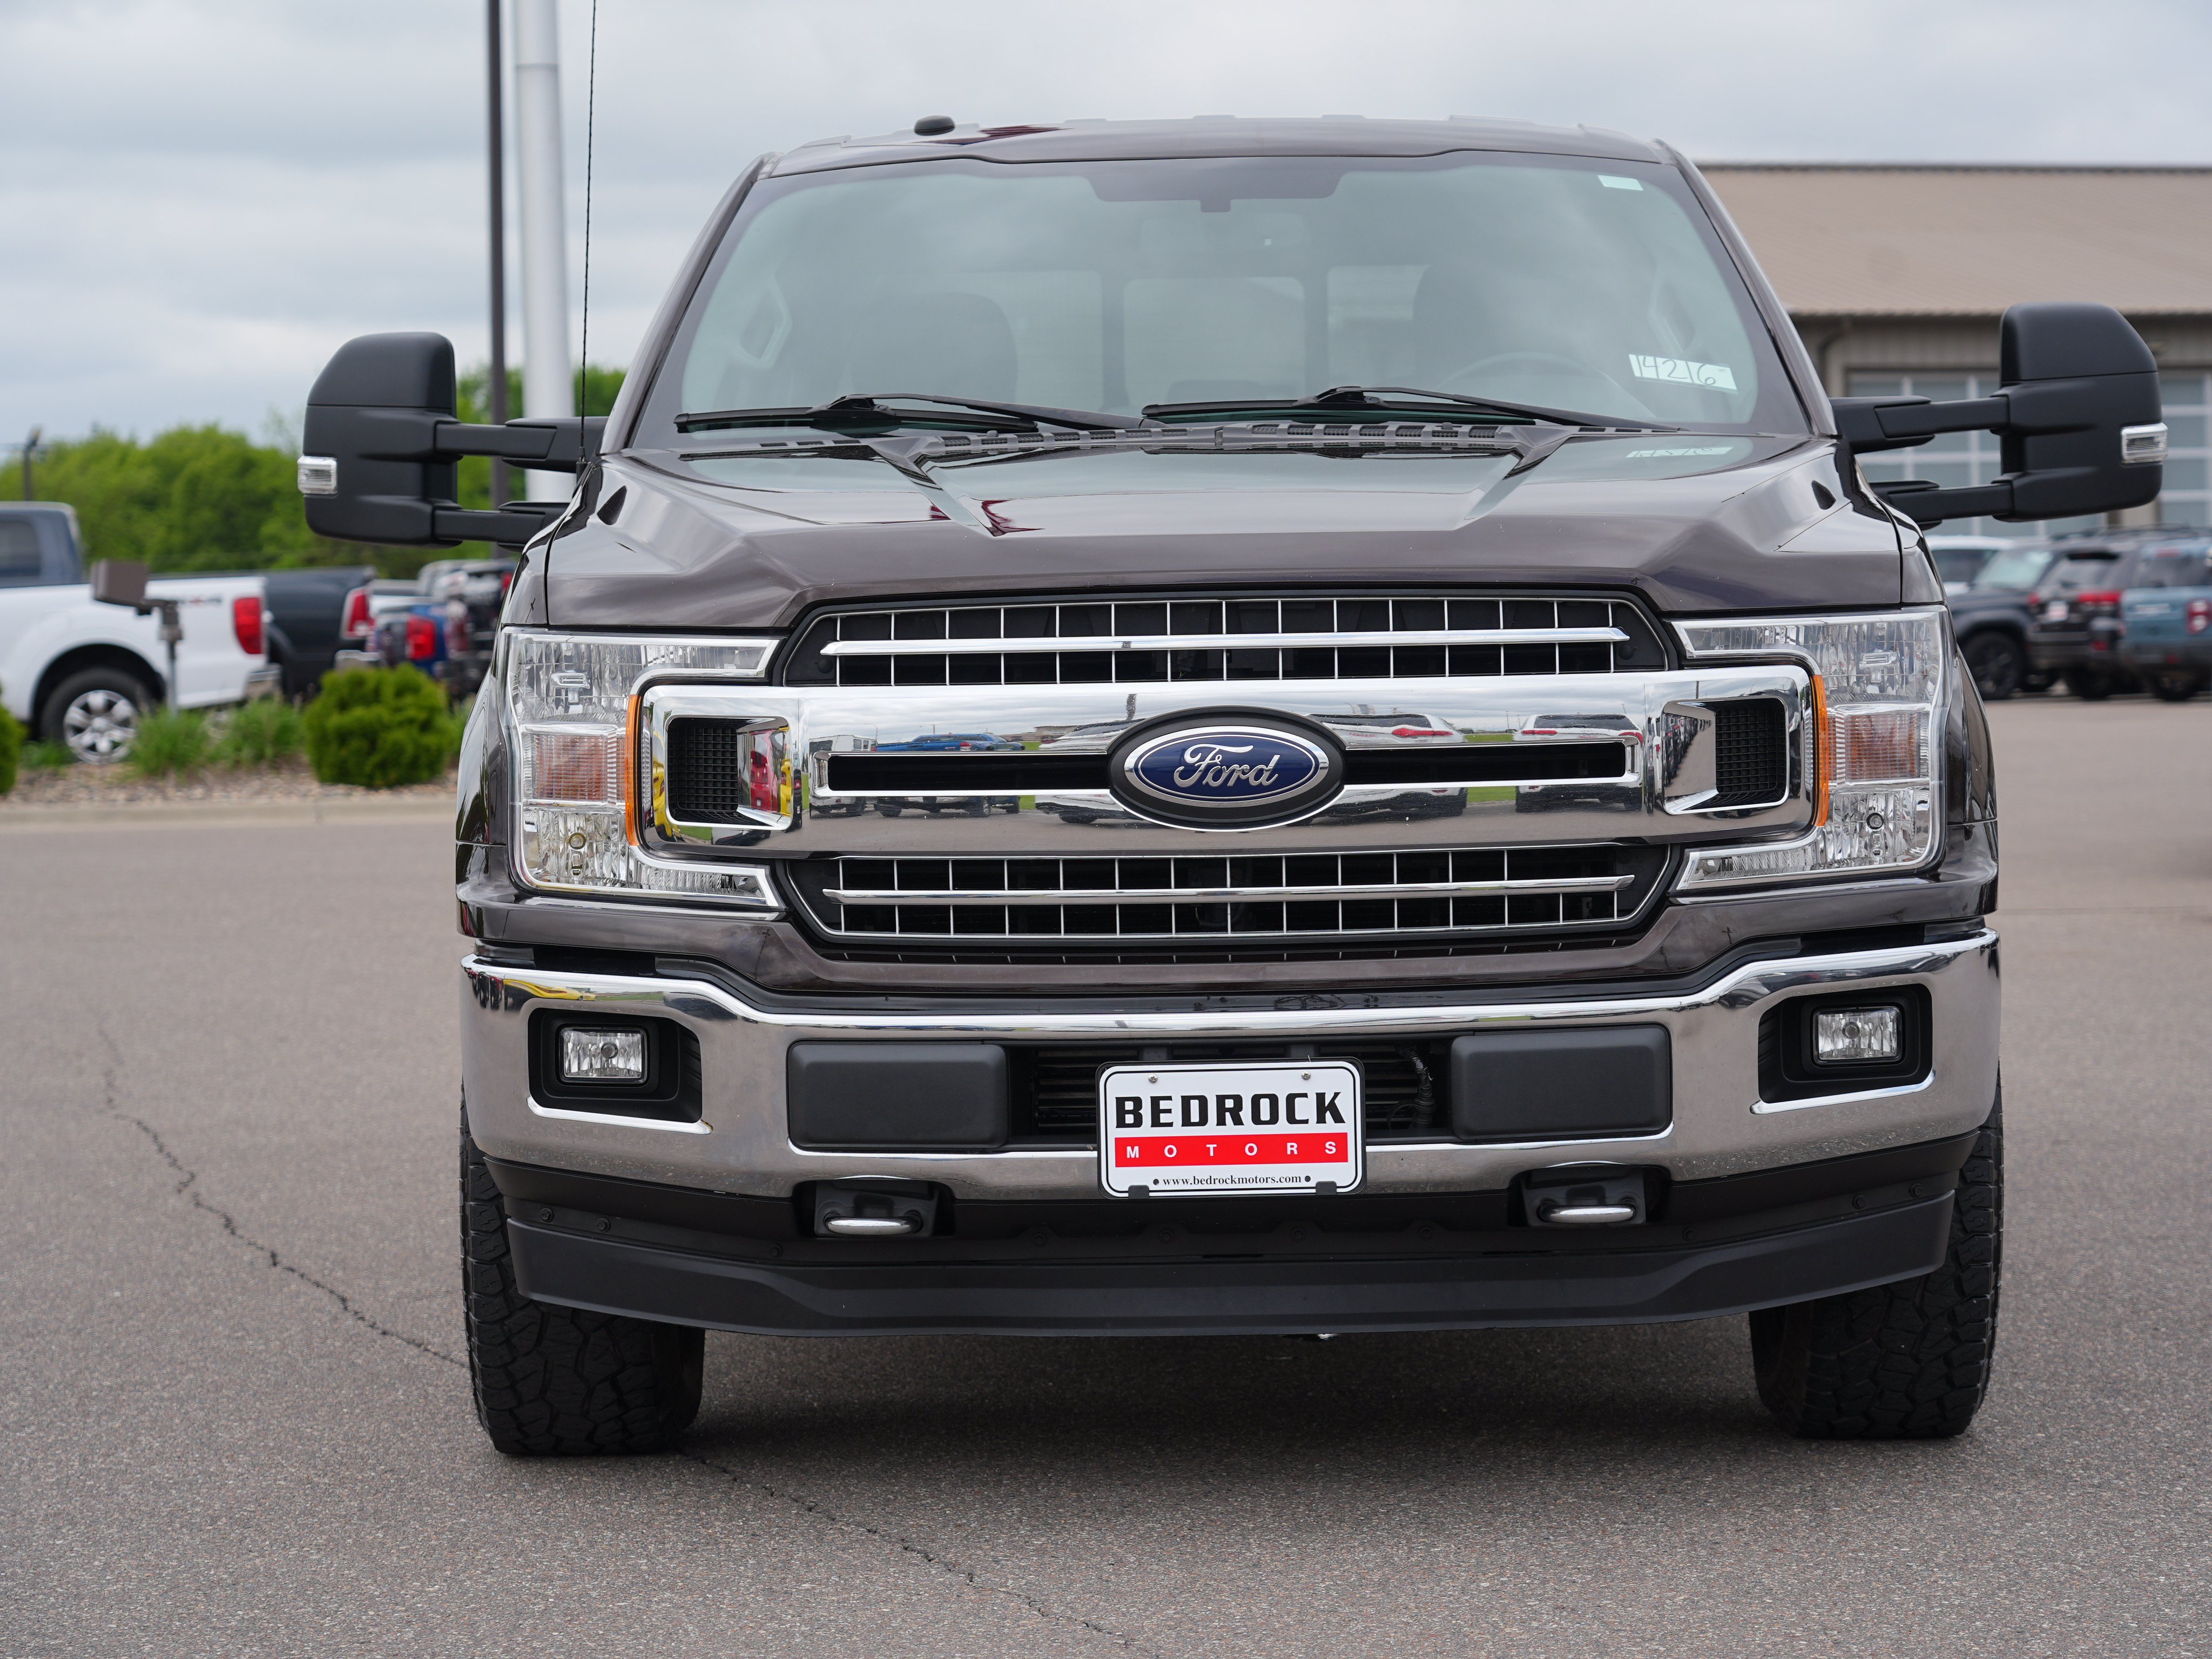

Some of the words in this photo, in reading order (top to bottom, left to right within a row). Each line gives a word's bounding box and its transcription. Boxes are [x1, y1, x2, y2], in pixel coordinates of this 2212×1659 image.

[1636, 355, 1716, 385] 14216
[1174, 744, 1280, 787] Ford
[1115, 1092, 1346, 1128] BEDROCK
[1126, 1141, 1337, 1158] MOTORS
[1163, 1175, 1301, 1186] www.bedrockmotors.com
